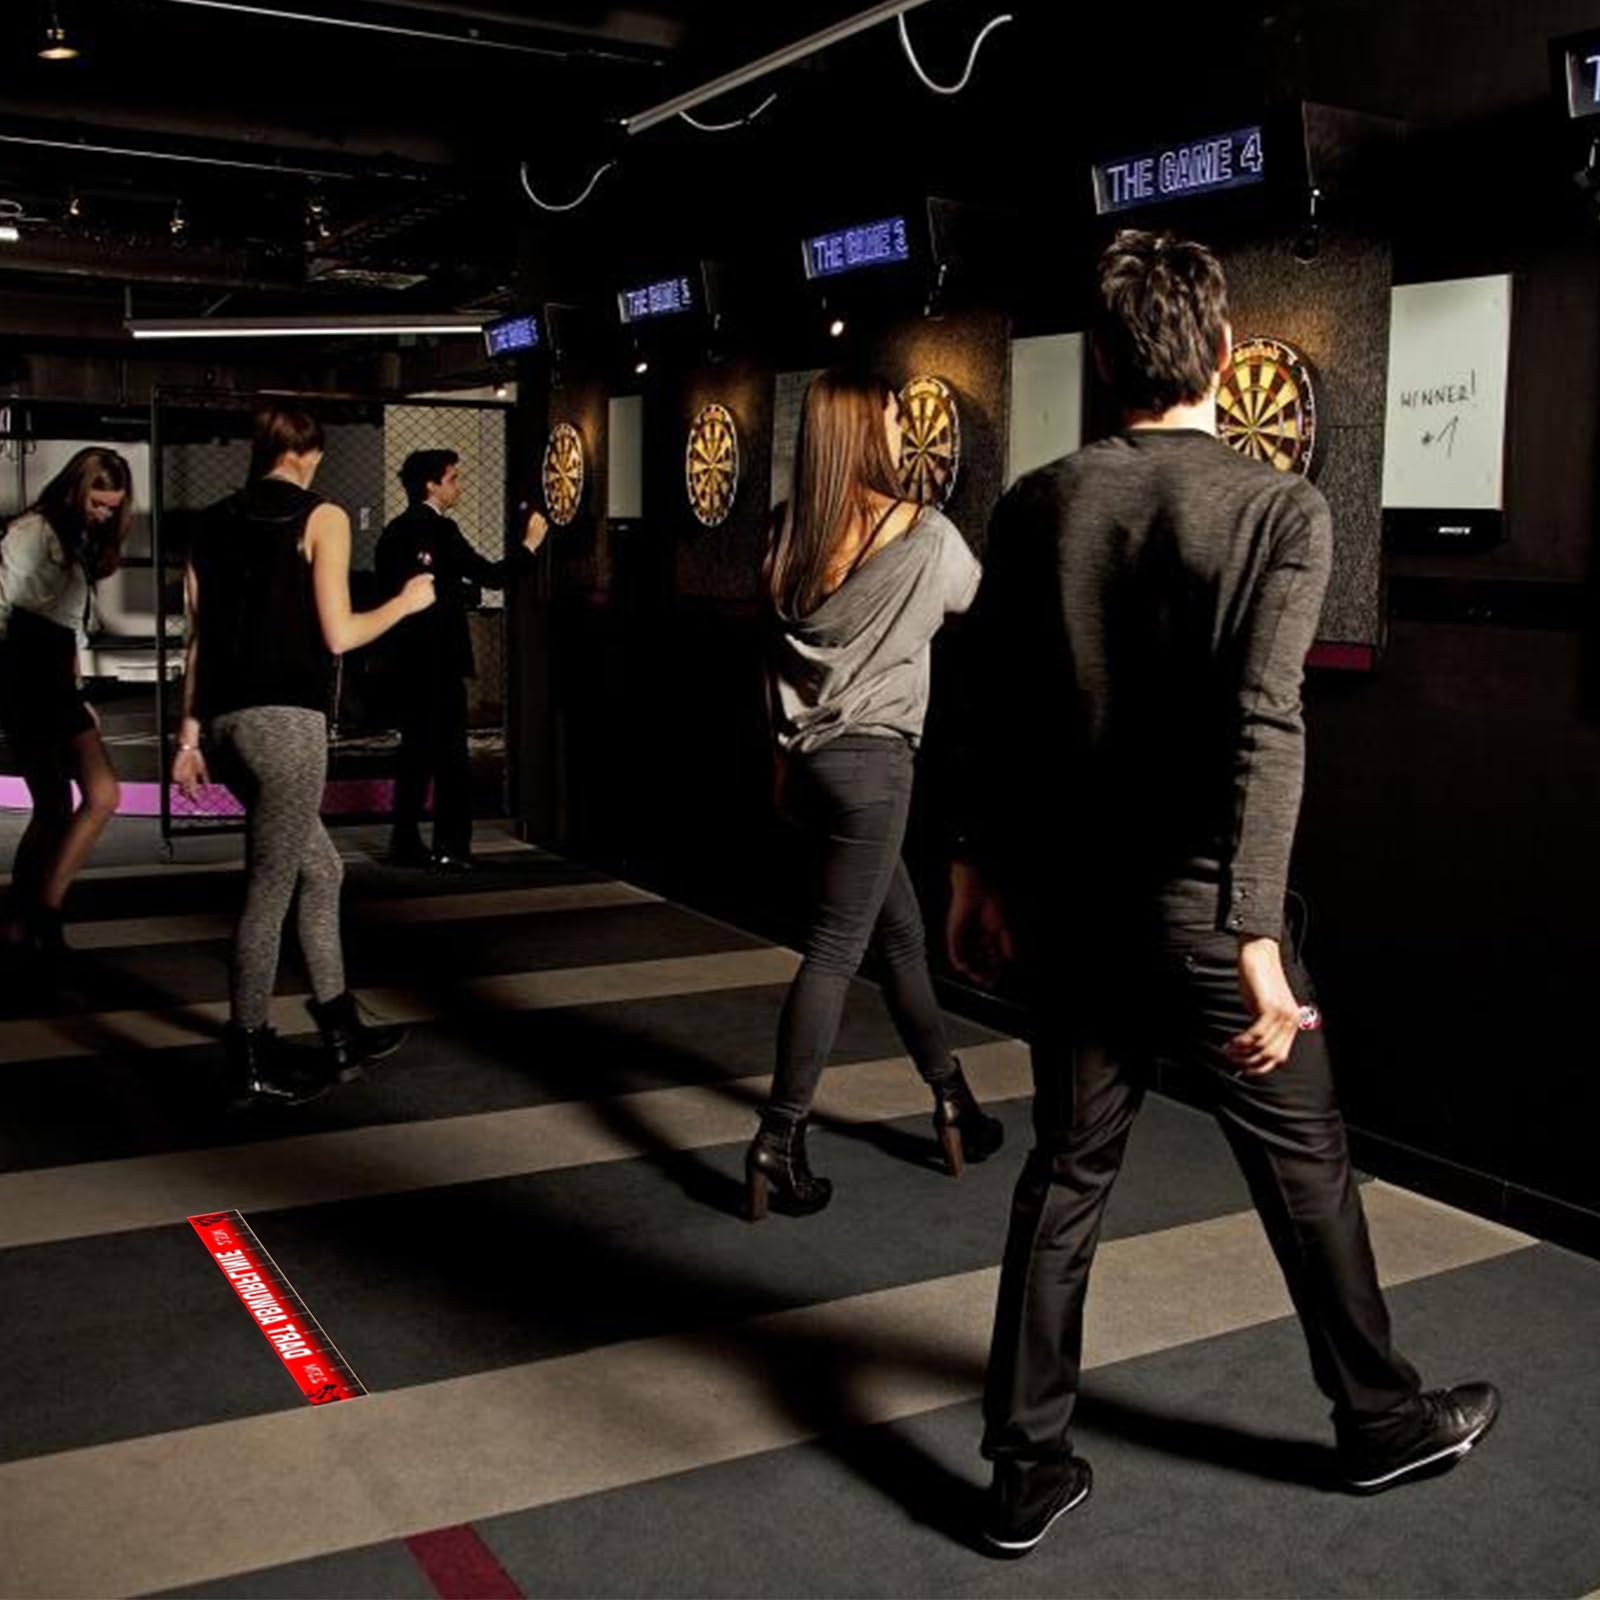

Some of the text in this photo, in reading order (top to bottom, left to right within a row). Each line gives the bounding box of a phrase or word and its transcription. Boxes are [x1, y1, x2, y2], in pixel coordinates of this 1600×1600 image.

[1107, 132, 1263, 202] THE GAME 4
[813, 236, 844, 271] THE
